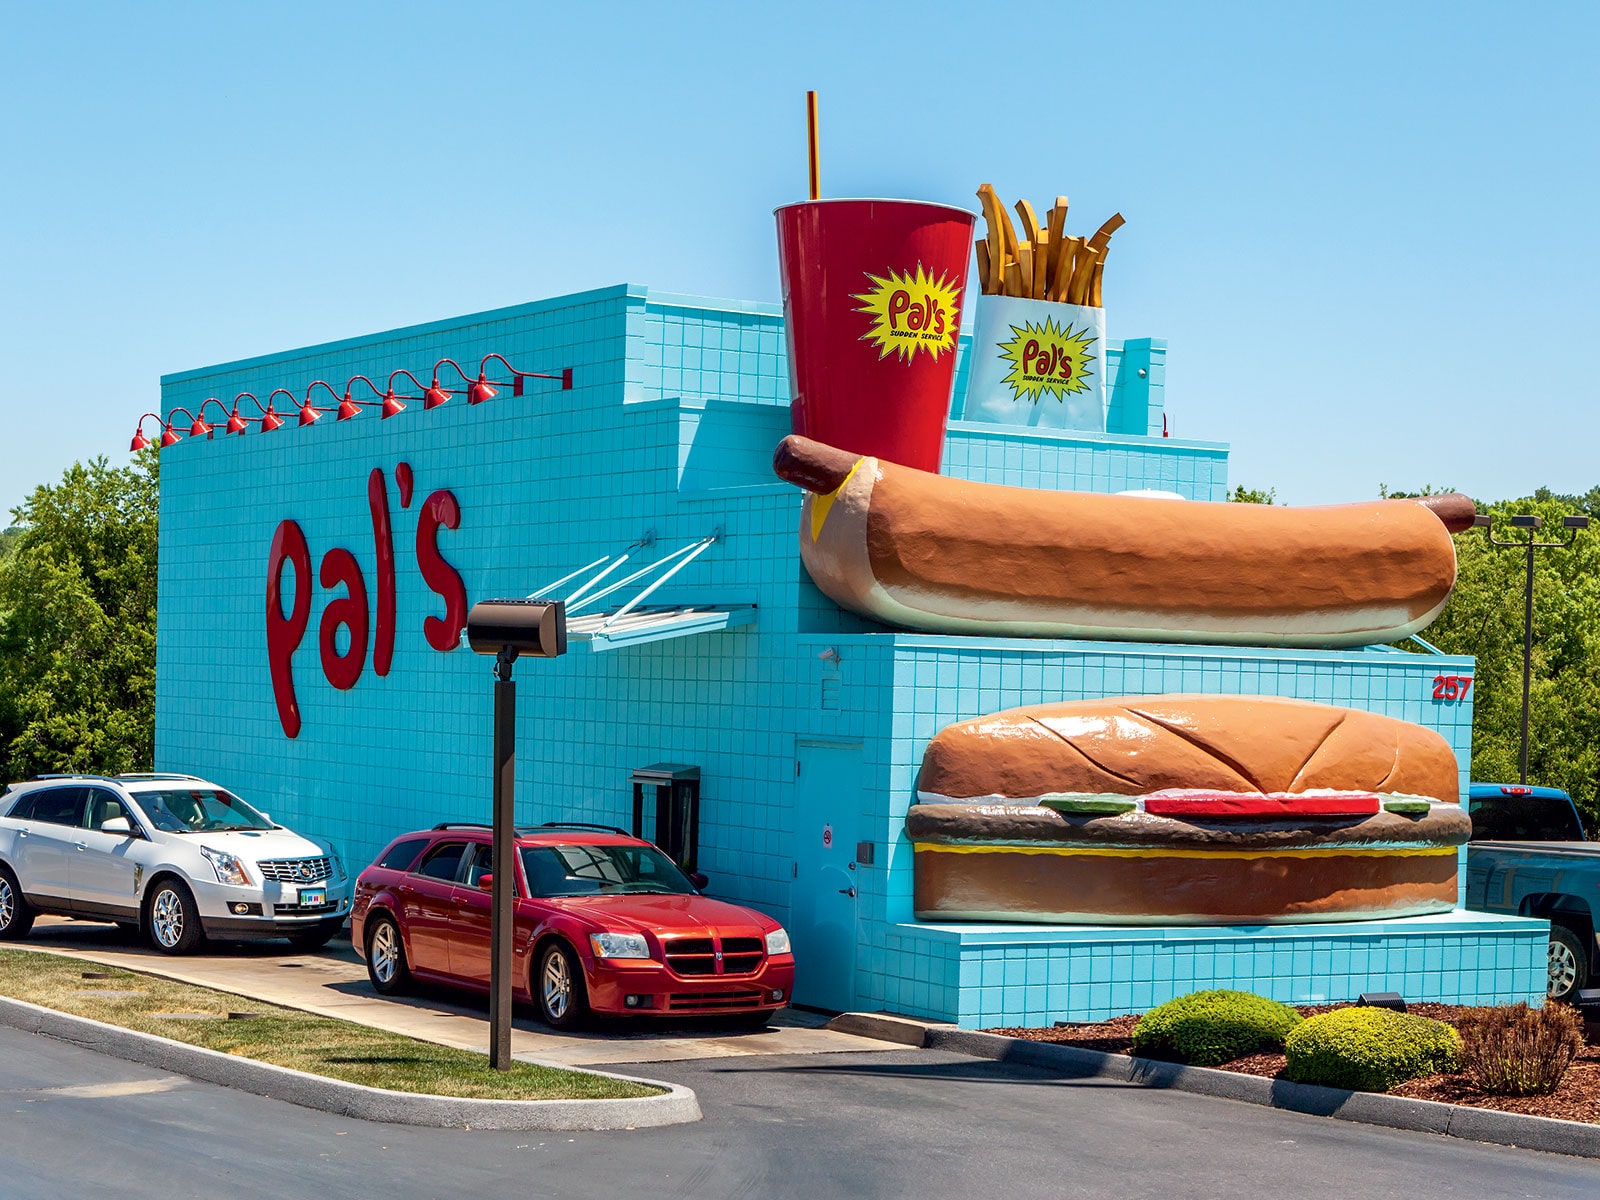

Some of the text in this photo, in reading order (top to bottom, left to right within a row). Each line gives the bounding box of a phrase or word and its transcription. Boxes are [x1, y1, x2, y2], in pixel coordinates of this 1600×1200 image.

[888, 290, 945, 334] Pal's
[890, 330, 943, 341] SUDDEN SERVICE
[1023, 339, 1072, 378] Pal's
[1046, 377, 1069, 385] SERVICE
[266, 462, 467, 738] Pal's
[1432, 675, 1473, 701] 257
